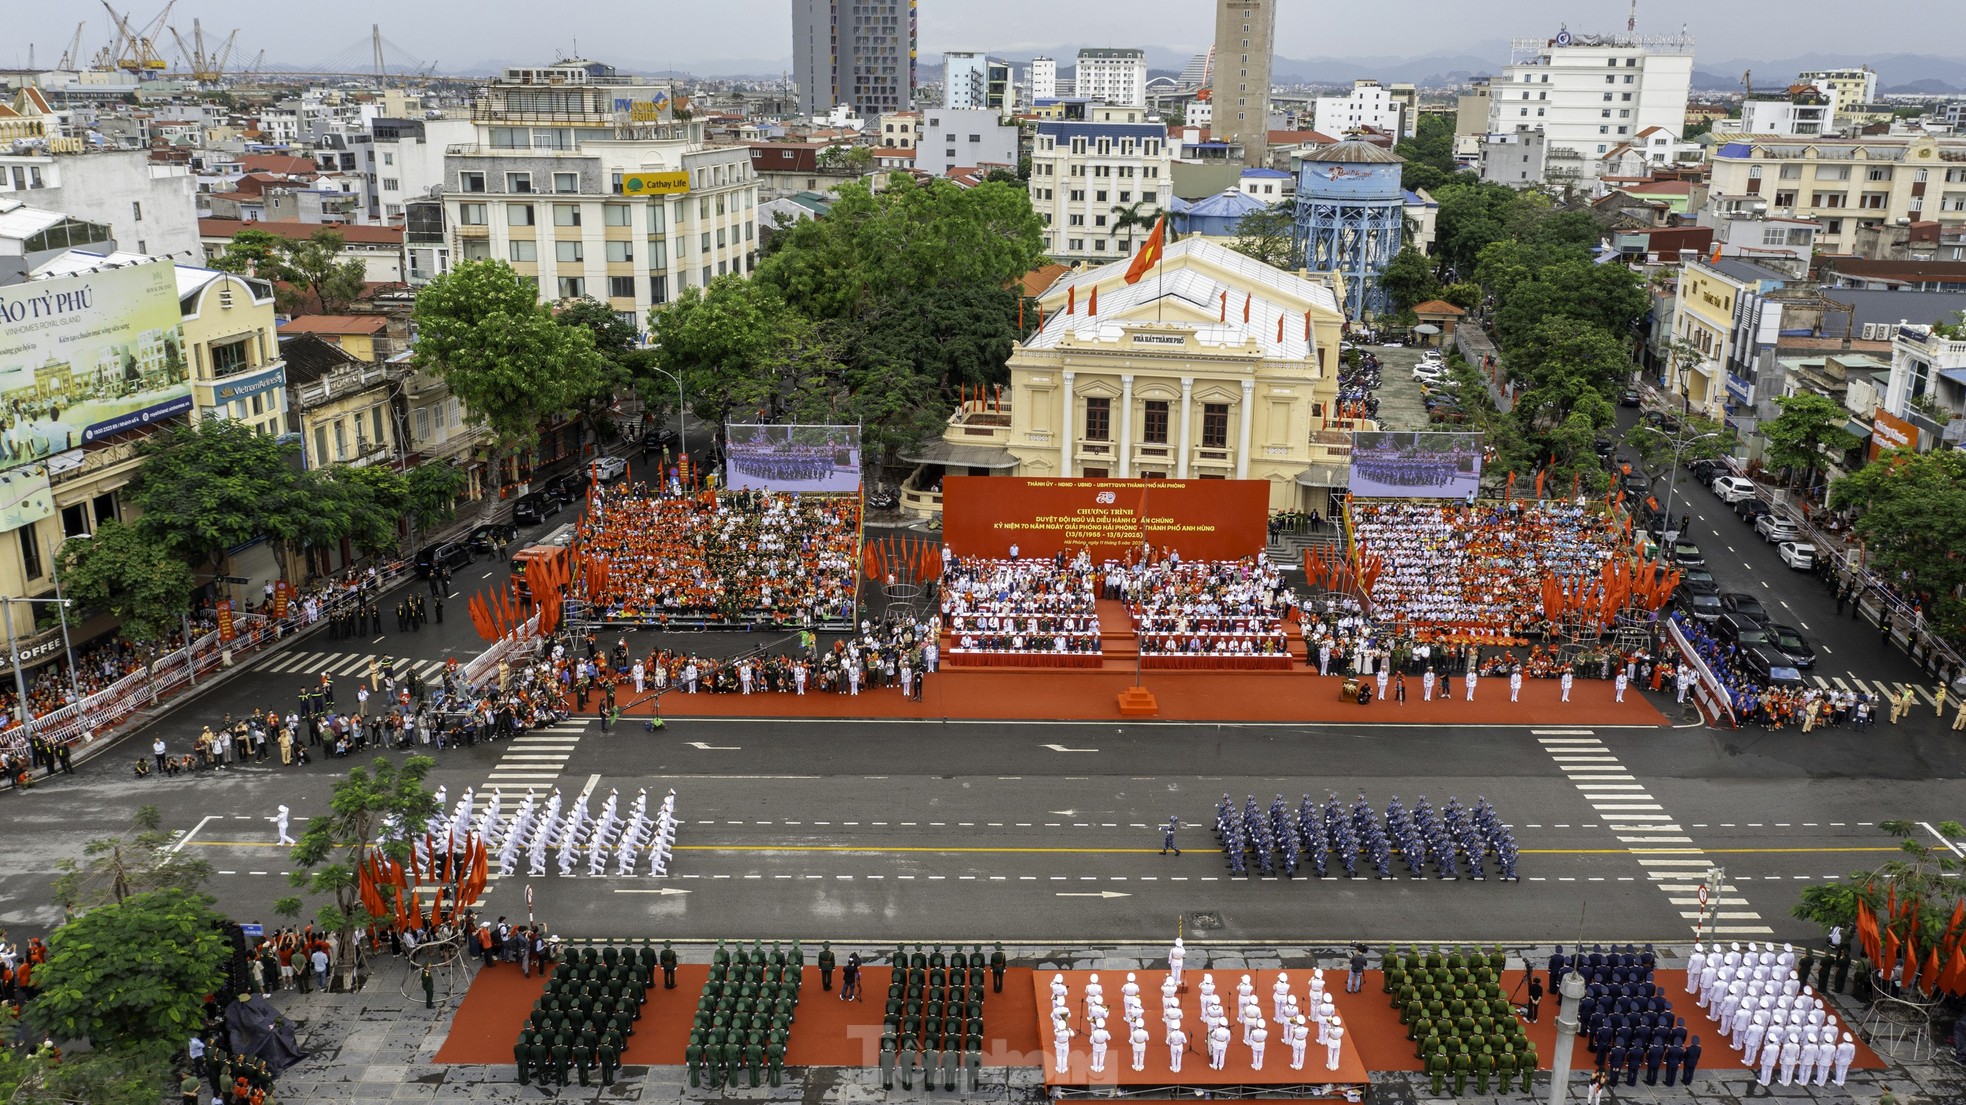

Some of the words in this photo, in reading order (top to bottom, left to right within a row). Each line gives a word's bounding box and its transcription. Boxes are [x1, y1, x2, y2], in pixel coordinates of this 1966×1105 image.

[632, 111, 658, 121] Bank
[646, 180, 672, 189] Cathay
[673, 179, 687, 188] Life
[28, 289, 52, 318] TỶ
[56, 284, 93, 313] PHÚ
[4, 324, 39, 337] VINHOMES
[40, 318, 59, 330] ROYAL
[60, 314, 82, 327] ISLAND
[1133, 334, 1145, 343] NHÀ
[1144, 335, 1156, 343] HÁT
[1155, 335, 1174, 344] THÀNH
[1173, 336, 1185, 344] PHỐ
[1036, 515, 1058, 523] DUYỆT
[1058, 516, 1070, 524] ĐỘI
[1004, 522, 1020, 530] NIỆM
[1065, 530, 1101, 538] (13/5/1955
